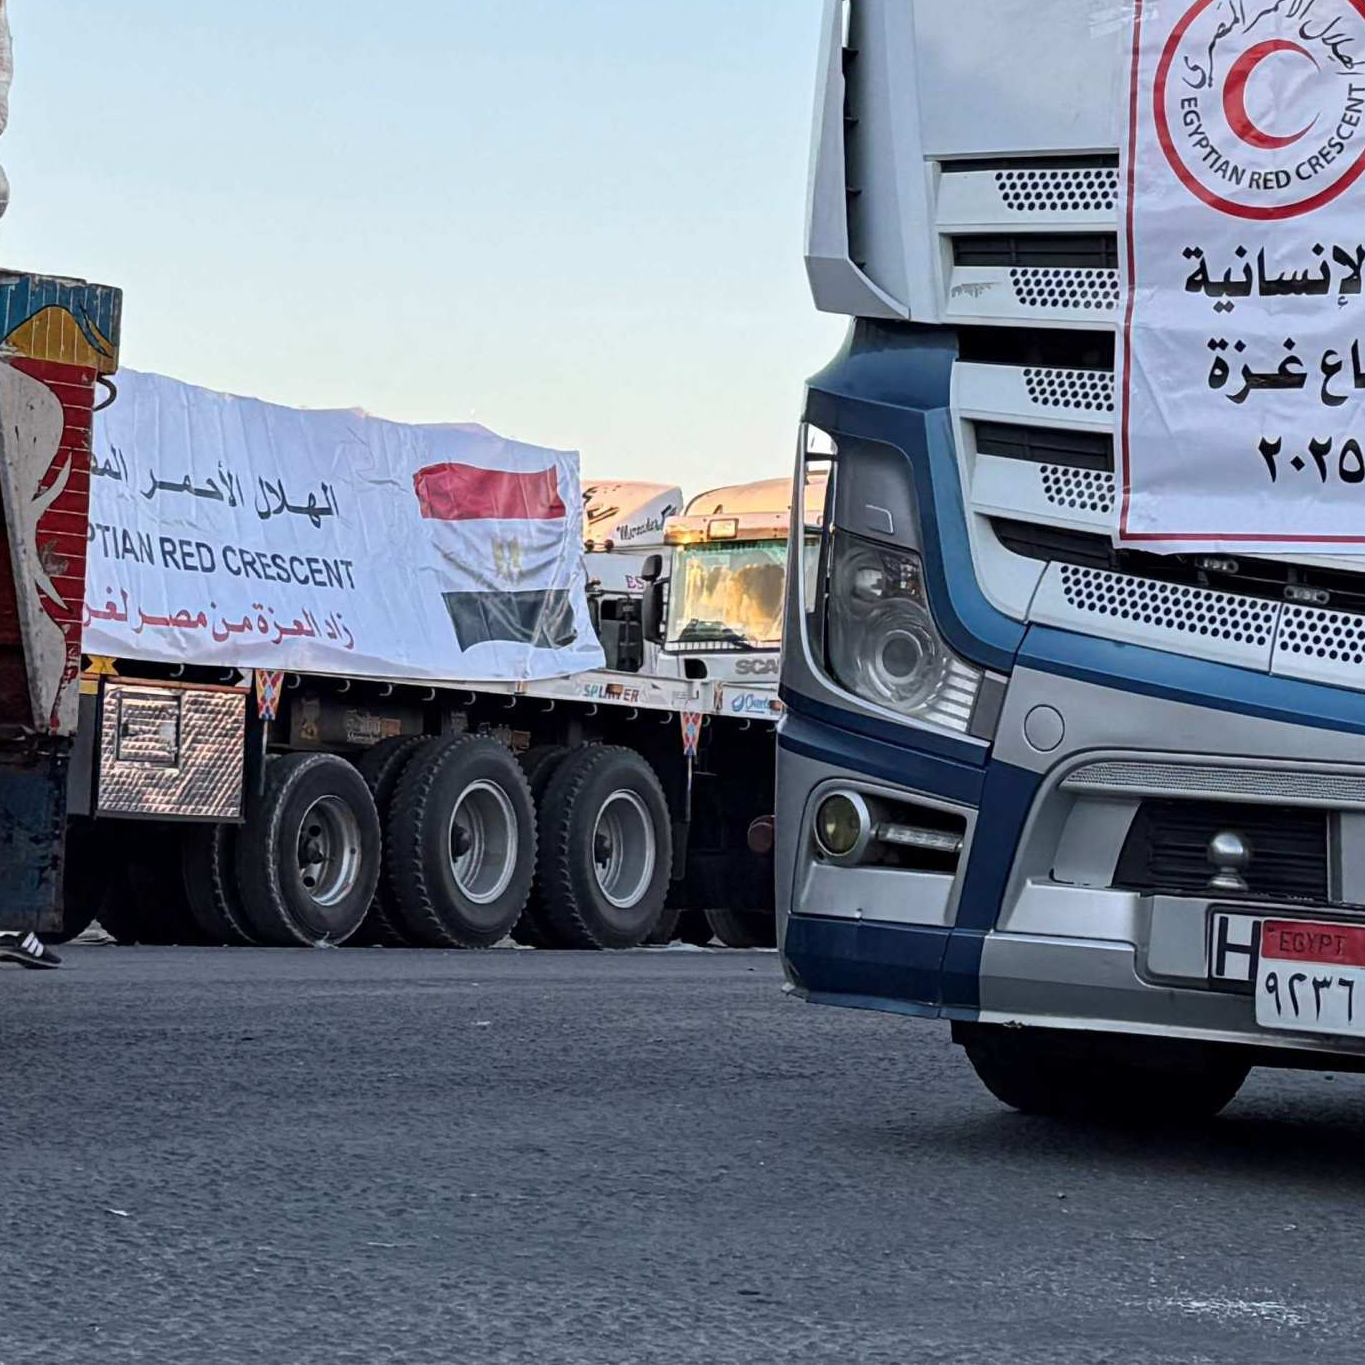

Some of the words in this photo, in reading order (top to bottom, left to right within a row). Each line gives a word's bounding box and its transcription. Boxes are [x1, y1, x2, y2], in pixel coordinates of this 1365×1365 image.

[1181, 96, 1246, 186] EGYPTIAN
[1248, 170, 1291, 190] RED
[1206, 337, 1307, 405] غزة
[140, 460, 244, 507] الأحمر
[1257, 434, 1365, 484] ٢٠٢٥
[255, 475, 340, 528] الهلال
[159, 537, 216, 573] RED
[222, 545, 356, 590] CRESCENT
[133, 606, 208, 634] مصر
[211, 601, 253, 643] من
[324, 613, 354, 649] زاد
[1279, 930, 1348, 956] EGYPT
[1265, 971, 1355, 1026] ٩٢٣٦
